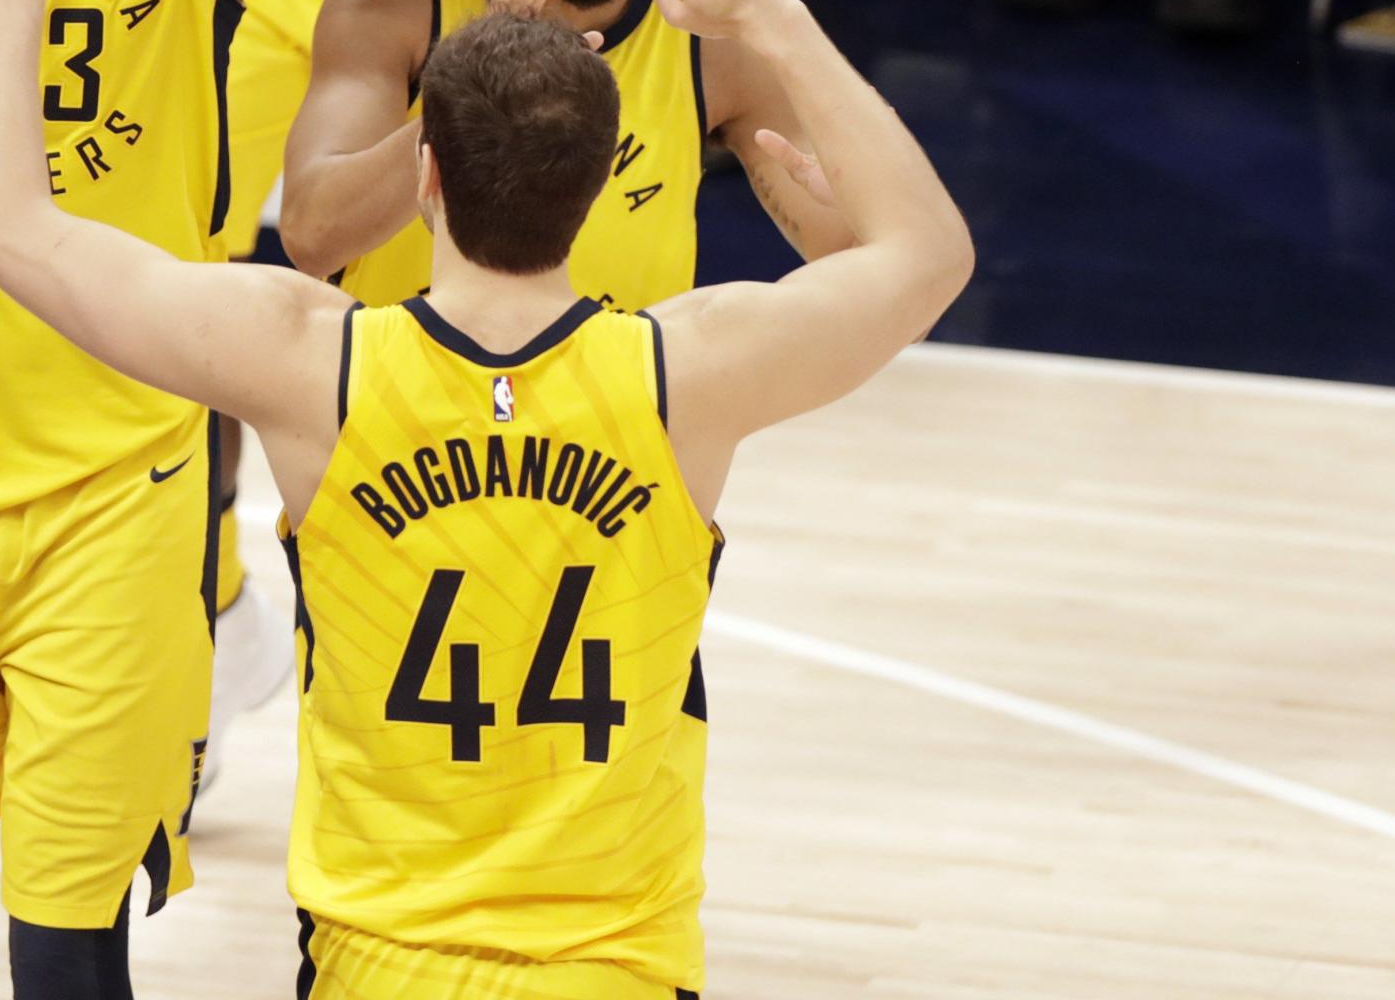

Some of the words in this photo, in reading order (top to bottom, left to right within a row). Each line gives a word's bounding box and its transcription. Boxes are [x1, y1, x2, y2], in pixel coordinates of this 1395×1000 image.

[43, 7, 105, 122] 3
[350, 434, 660, 540] BOGDANOVIĆ
[384, 565, 626, 764] 44
